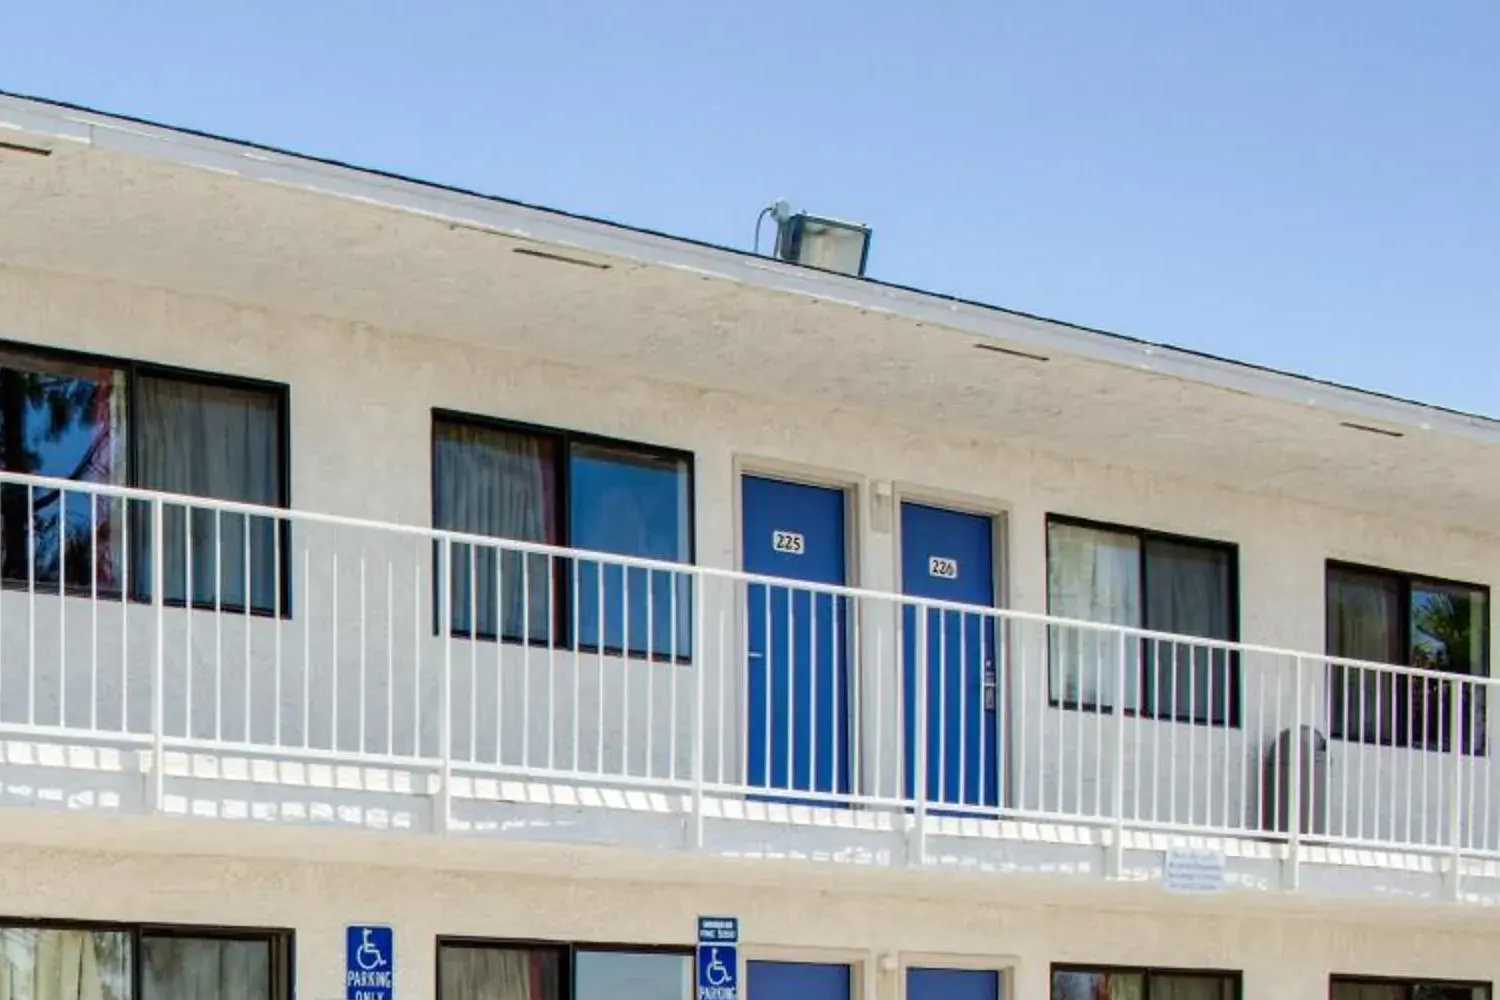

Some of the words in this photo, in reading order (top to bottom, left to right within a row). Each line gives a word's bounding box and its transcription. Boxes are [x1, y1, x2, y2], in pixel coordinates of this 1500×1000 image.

[775, 533, 802, 551] 225
[931, 559, 954, 577] 226
[347, 970, 392, 988] PARKING
